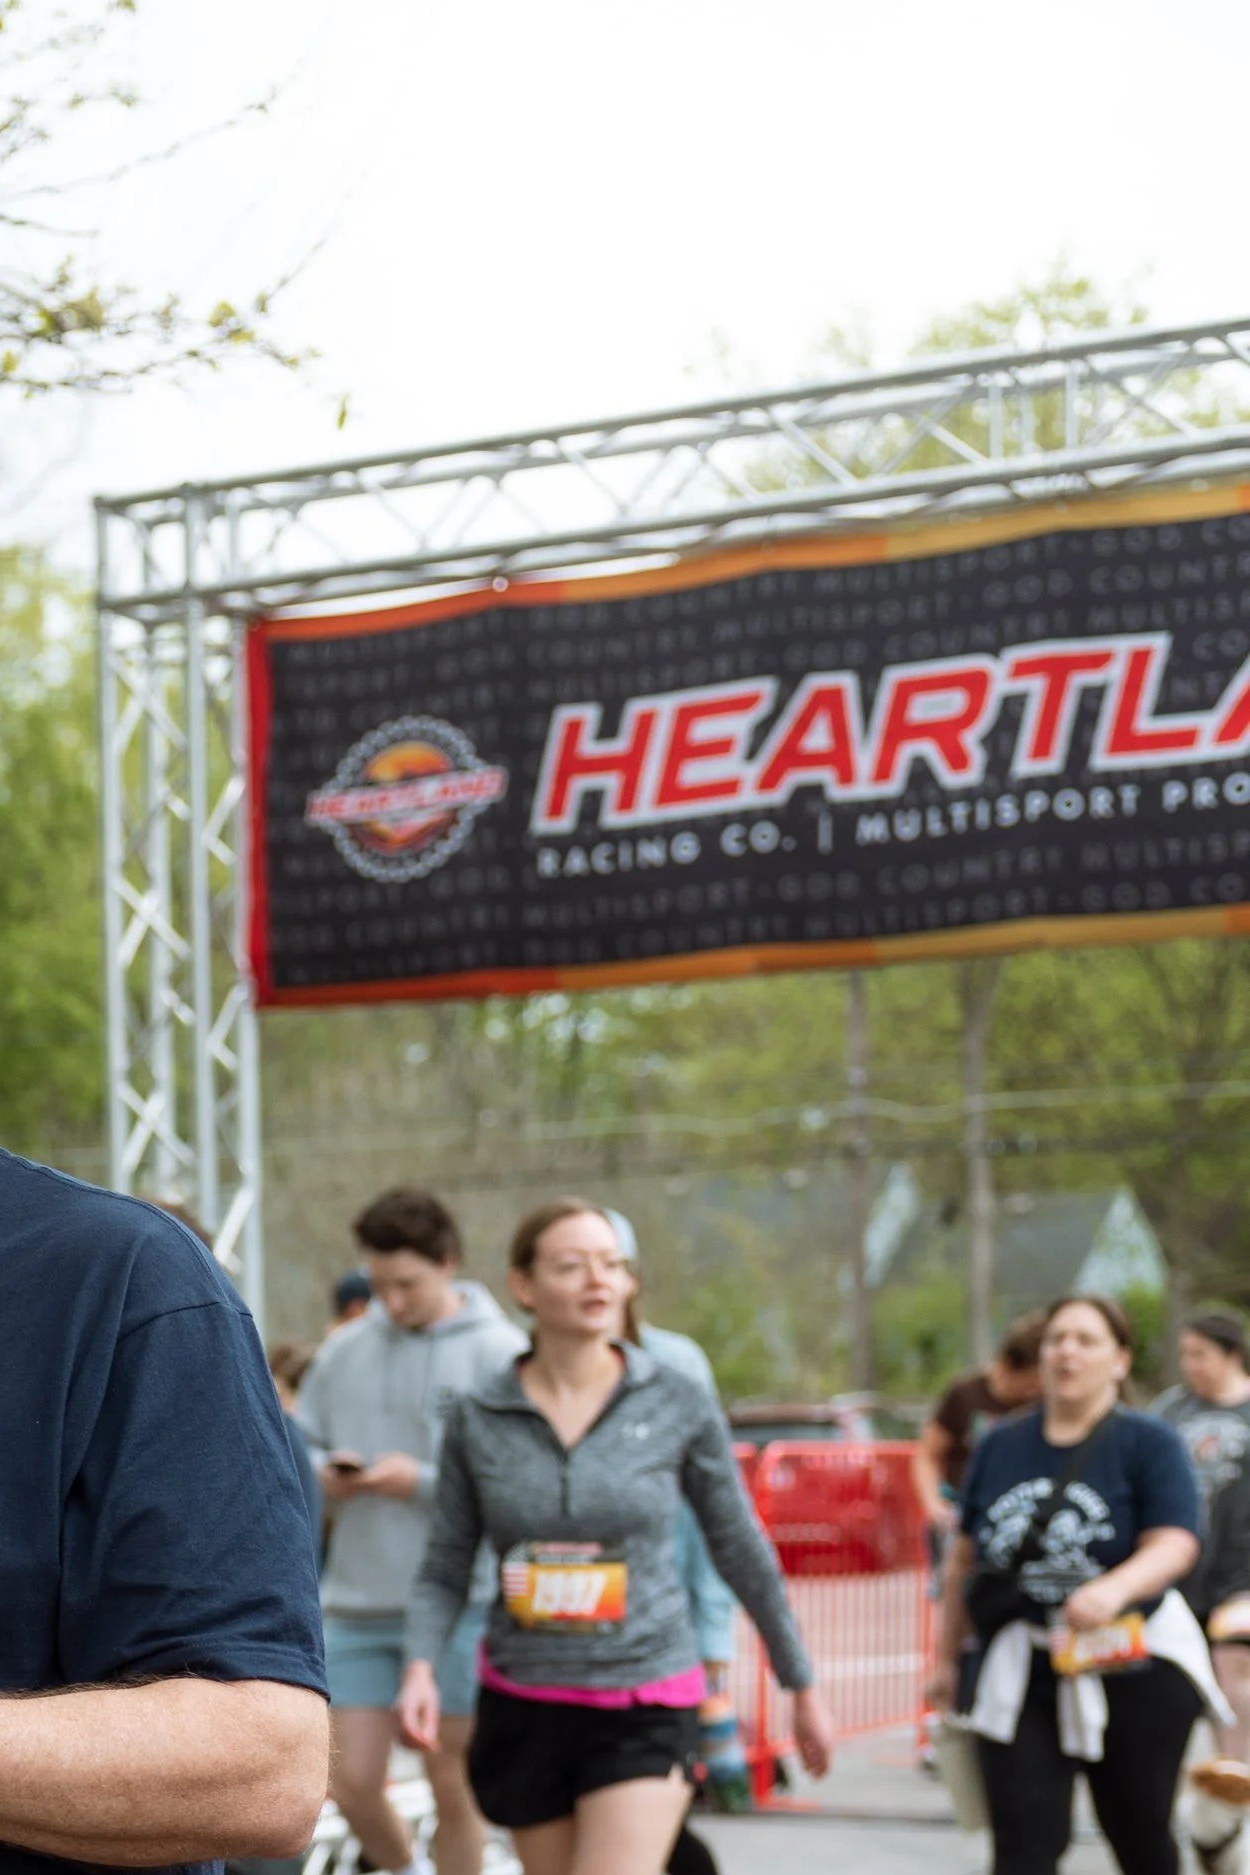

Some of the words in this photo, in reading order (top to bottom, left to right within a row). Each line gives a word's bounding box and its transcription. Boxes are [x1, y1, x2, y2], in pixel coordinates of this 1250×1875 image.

[536, 830, 703, 878] RACING
[719, 820, 796, 857] CO.
[855, 783, 1141, 846] MULTISPORT
[1161, 771, 1250, 814] PRO
